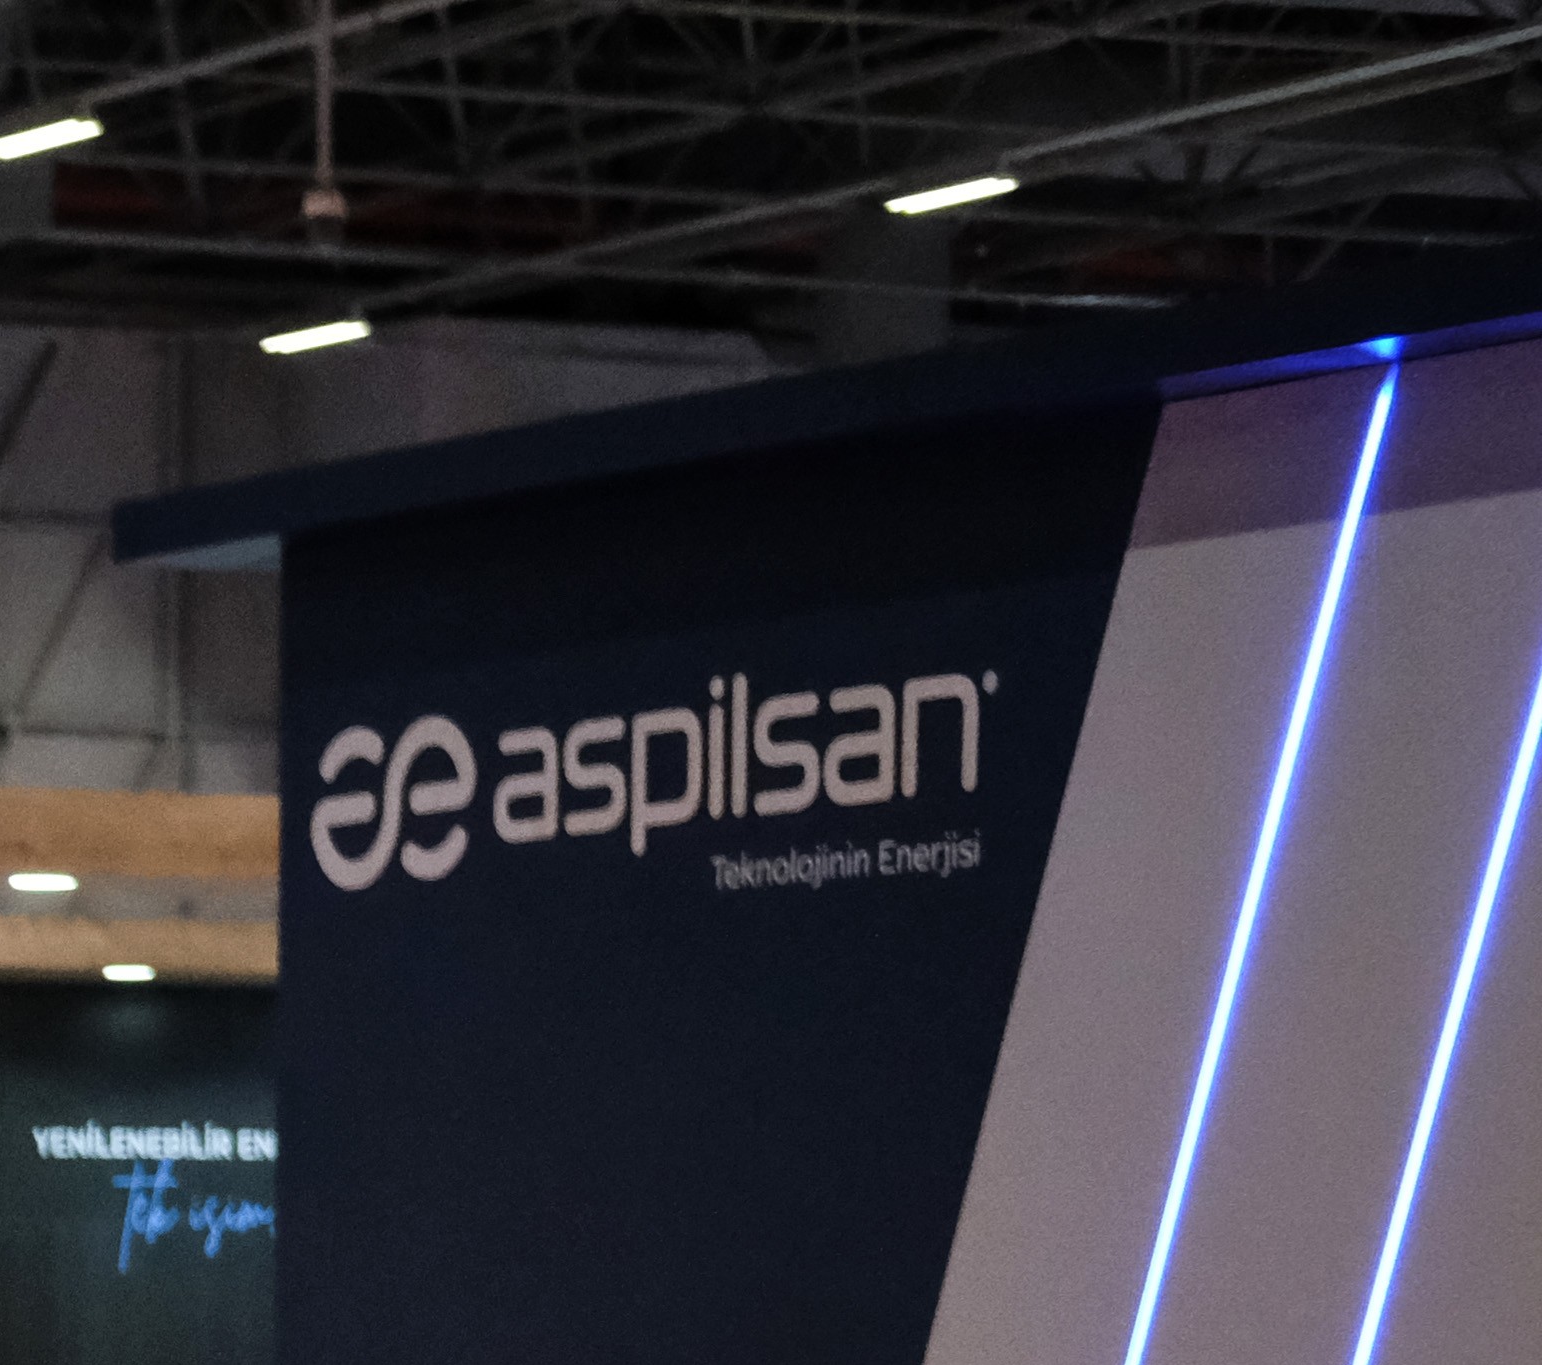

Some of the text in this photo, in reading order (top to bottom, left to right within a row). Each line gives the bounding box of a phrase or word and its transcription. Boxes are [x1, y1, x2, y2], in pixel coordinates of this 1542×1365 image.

[493, 673, 980, 857] aspilsan
[711, 829, 981, 890] Teknolojinin Enerjisi
